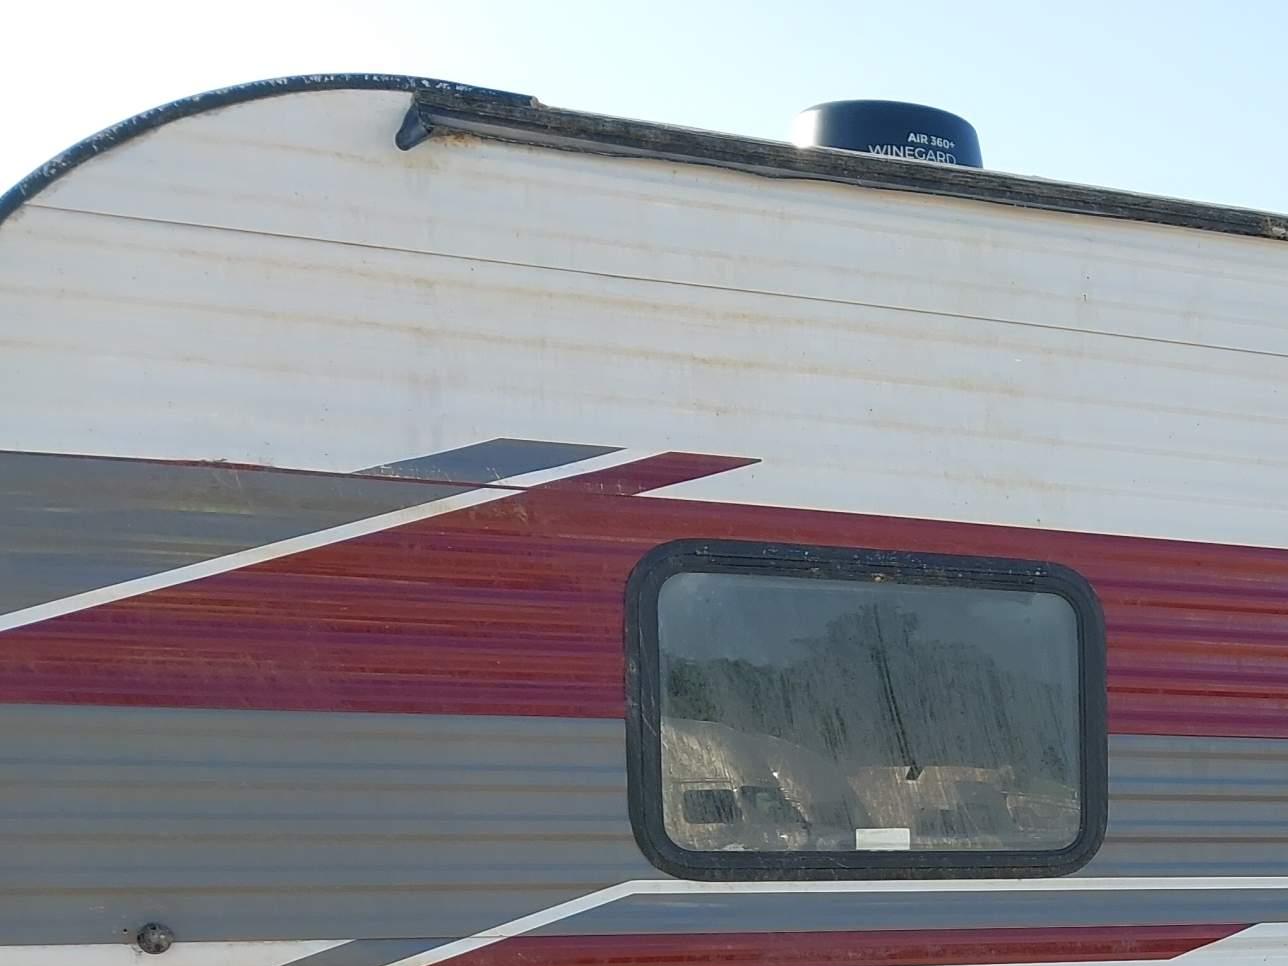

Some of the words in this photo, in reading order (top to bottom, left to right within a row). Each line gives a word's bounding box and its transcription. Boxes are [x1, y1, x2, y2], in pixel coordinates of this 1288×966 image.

[907, 132, 928, 145] AIR
[930, 136, 956, 149] 360+
[868, 144, 956, 164] WINEGARD
